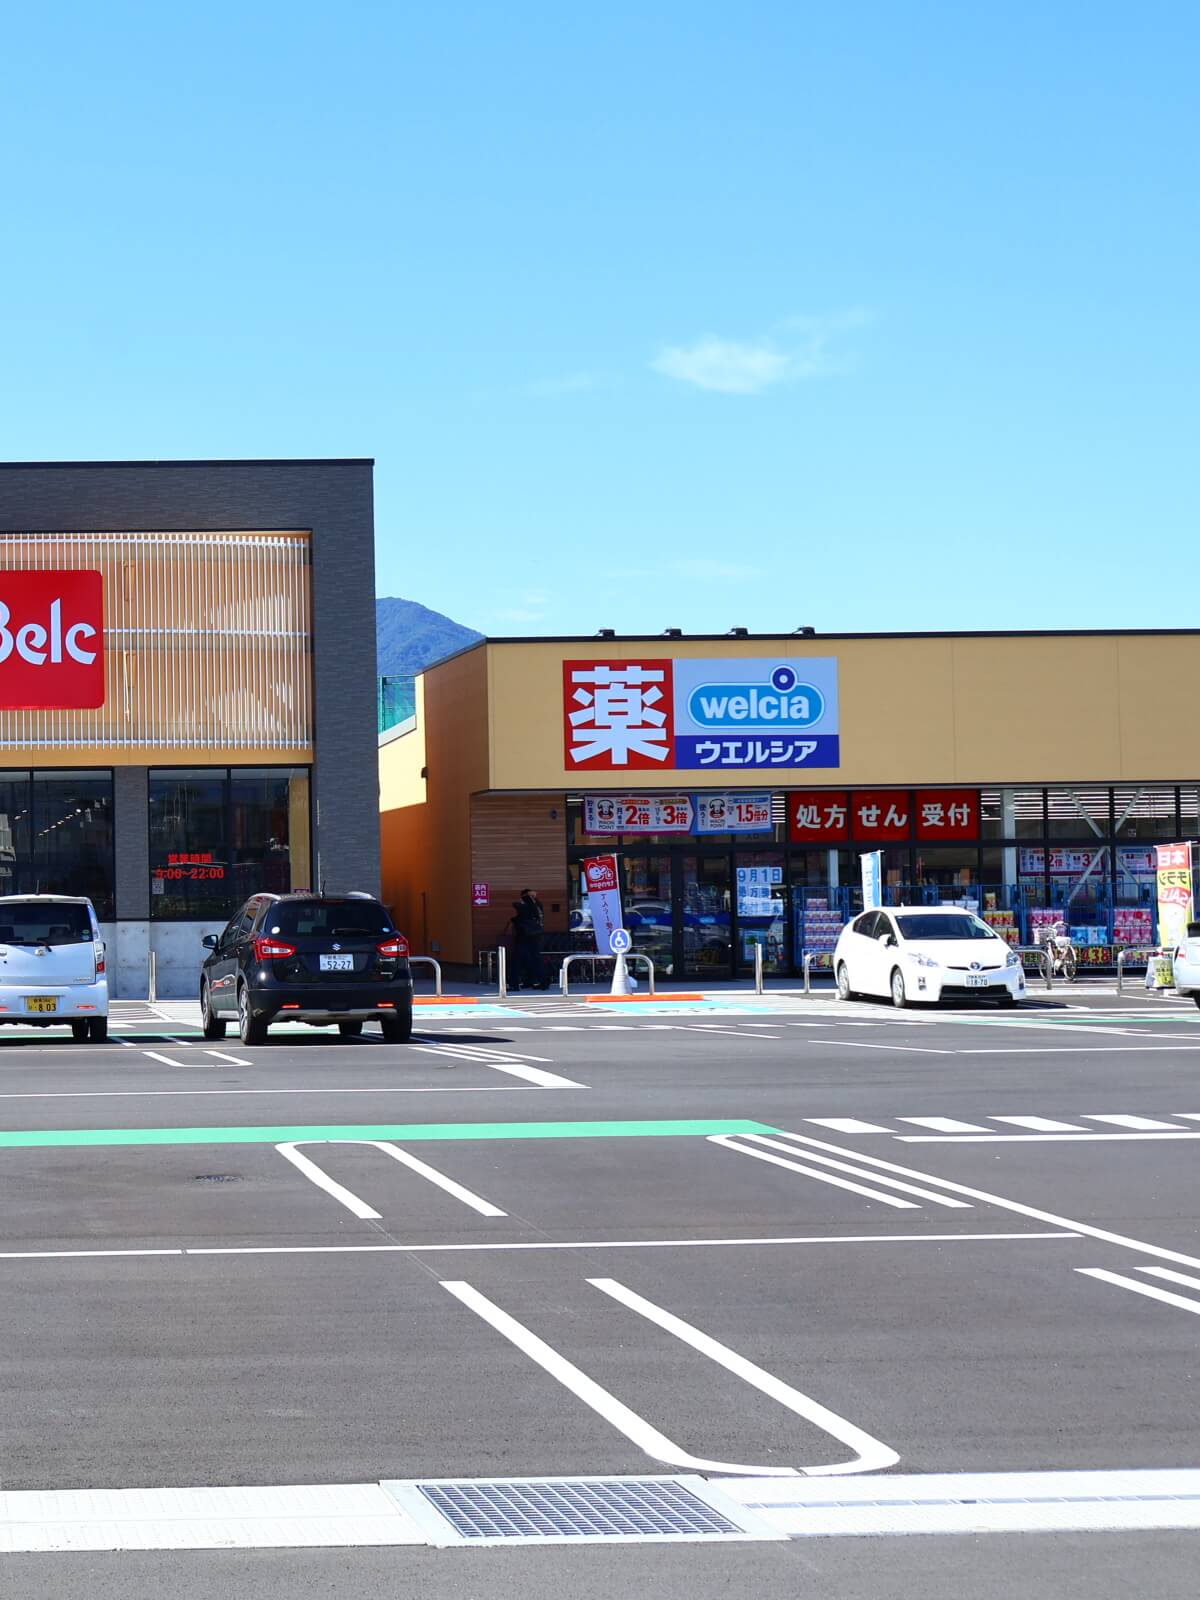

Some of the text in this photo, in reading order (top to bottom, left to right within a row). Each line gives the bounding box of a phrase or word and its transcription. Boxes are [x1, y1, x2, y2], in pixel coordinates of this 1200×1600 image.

[568, 666, 670, 765] 薬
[700, 688, 810, 720] welcia
[695, 740, 818, 764] ウエルシア
[796, 803, 971, 829] 処方 せん 受付
[738, 868, 780, 883] 9月1日
